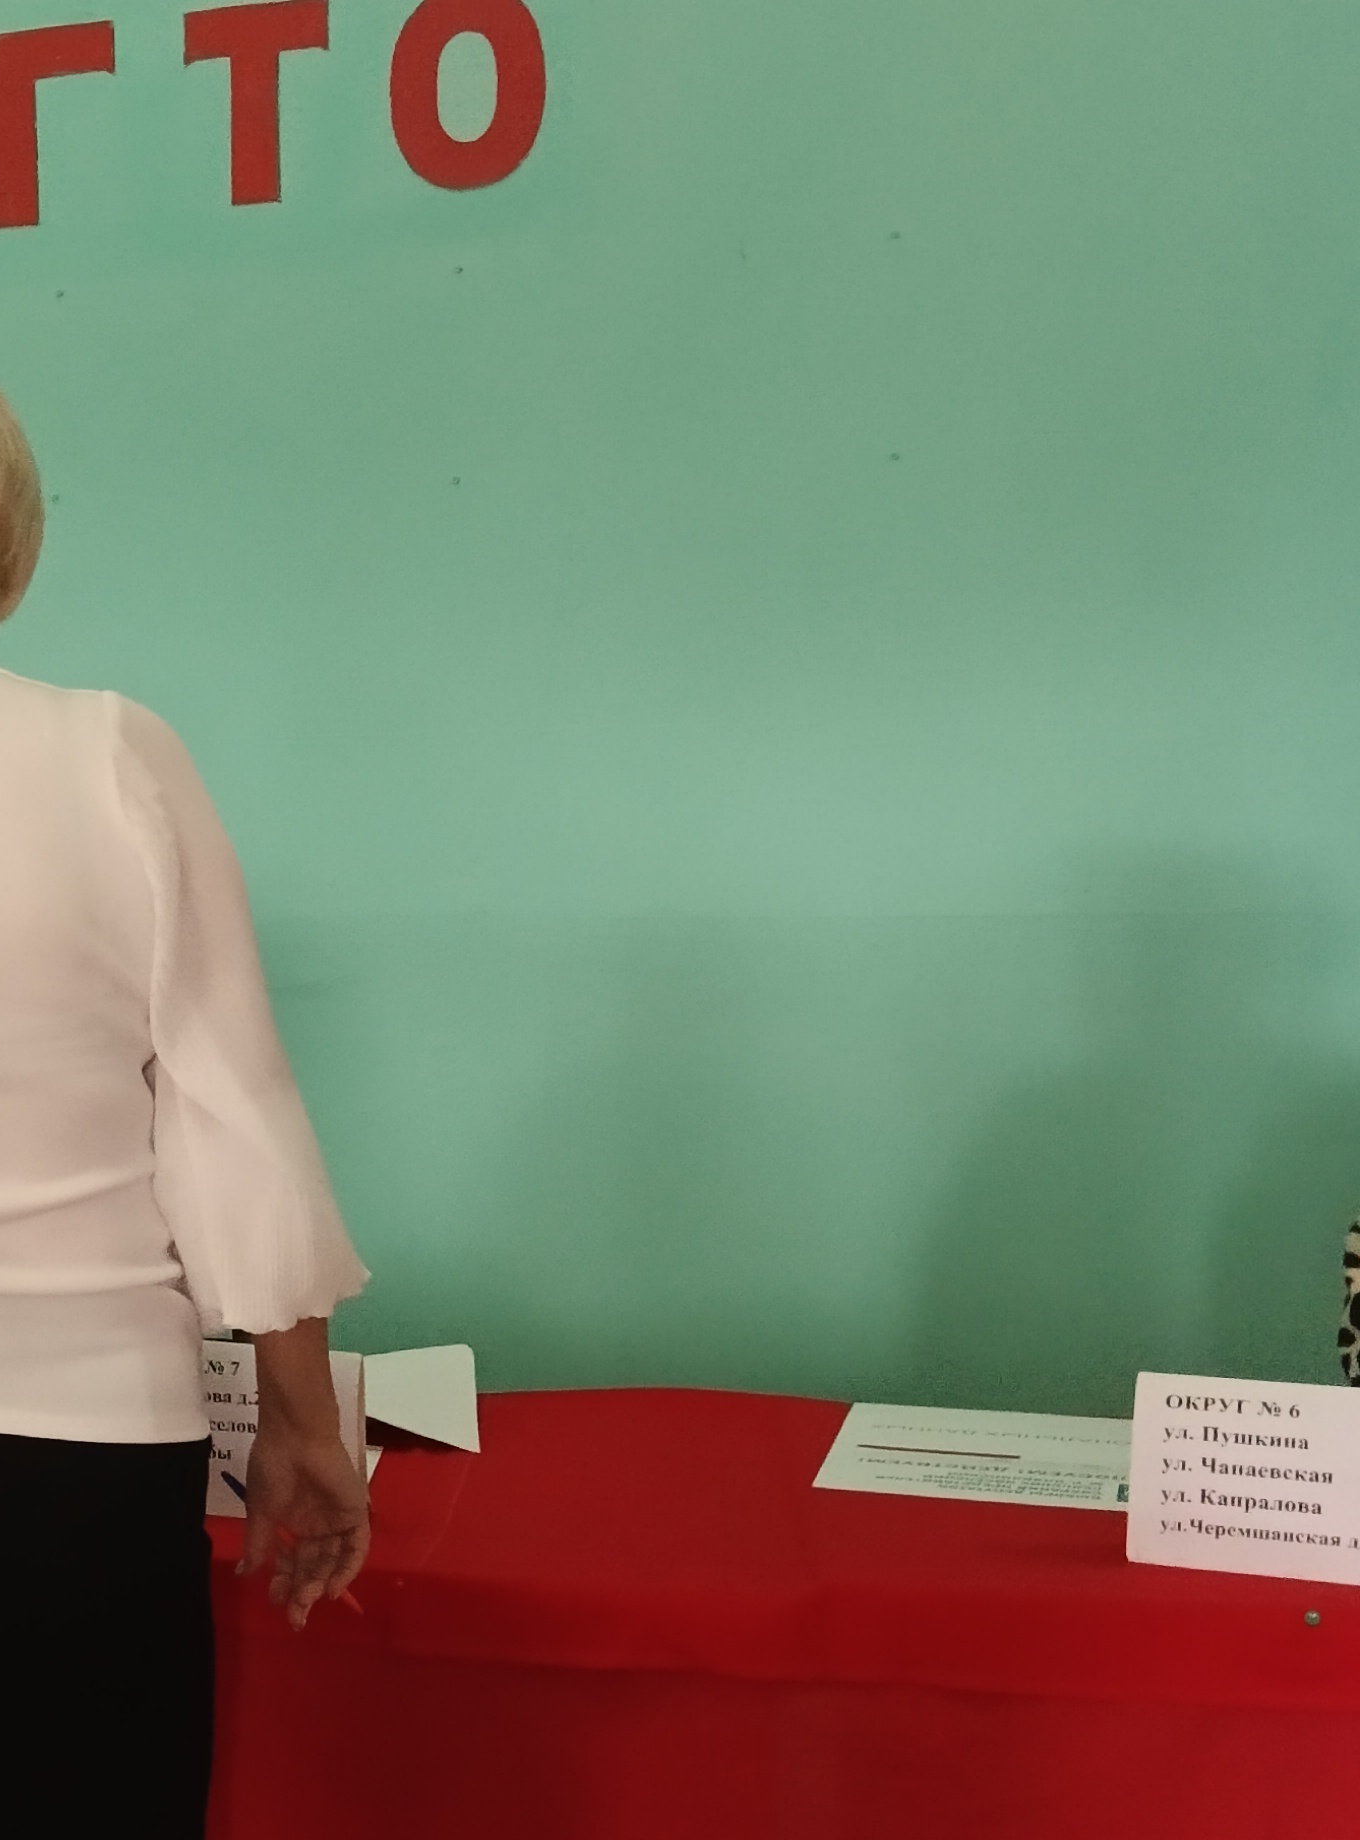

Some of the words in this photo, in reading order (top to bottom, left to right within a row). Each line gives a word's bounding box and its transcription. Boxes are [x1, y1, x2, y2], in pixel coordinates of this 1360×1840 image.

[230, 1361, 240, 1377] 7
[1166, 1394, 1250, 1415] ОКРУГ
[1257, 1401, 1281, 1417] №
[1289, 1404, 1300, 1418] 6
[1163, 1427, 1194, 1442] ул.
[1203, 1426, 1309, 1450] Пушкина
[1162, 1458, 1192, 1474] ул.
[1201, 1456, 1333, 1484] Чапаевская
[1161, 1489, 1191, 1505] ул.
[1200, 1488, 1322, 1515] Капралова
